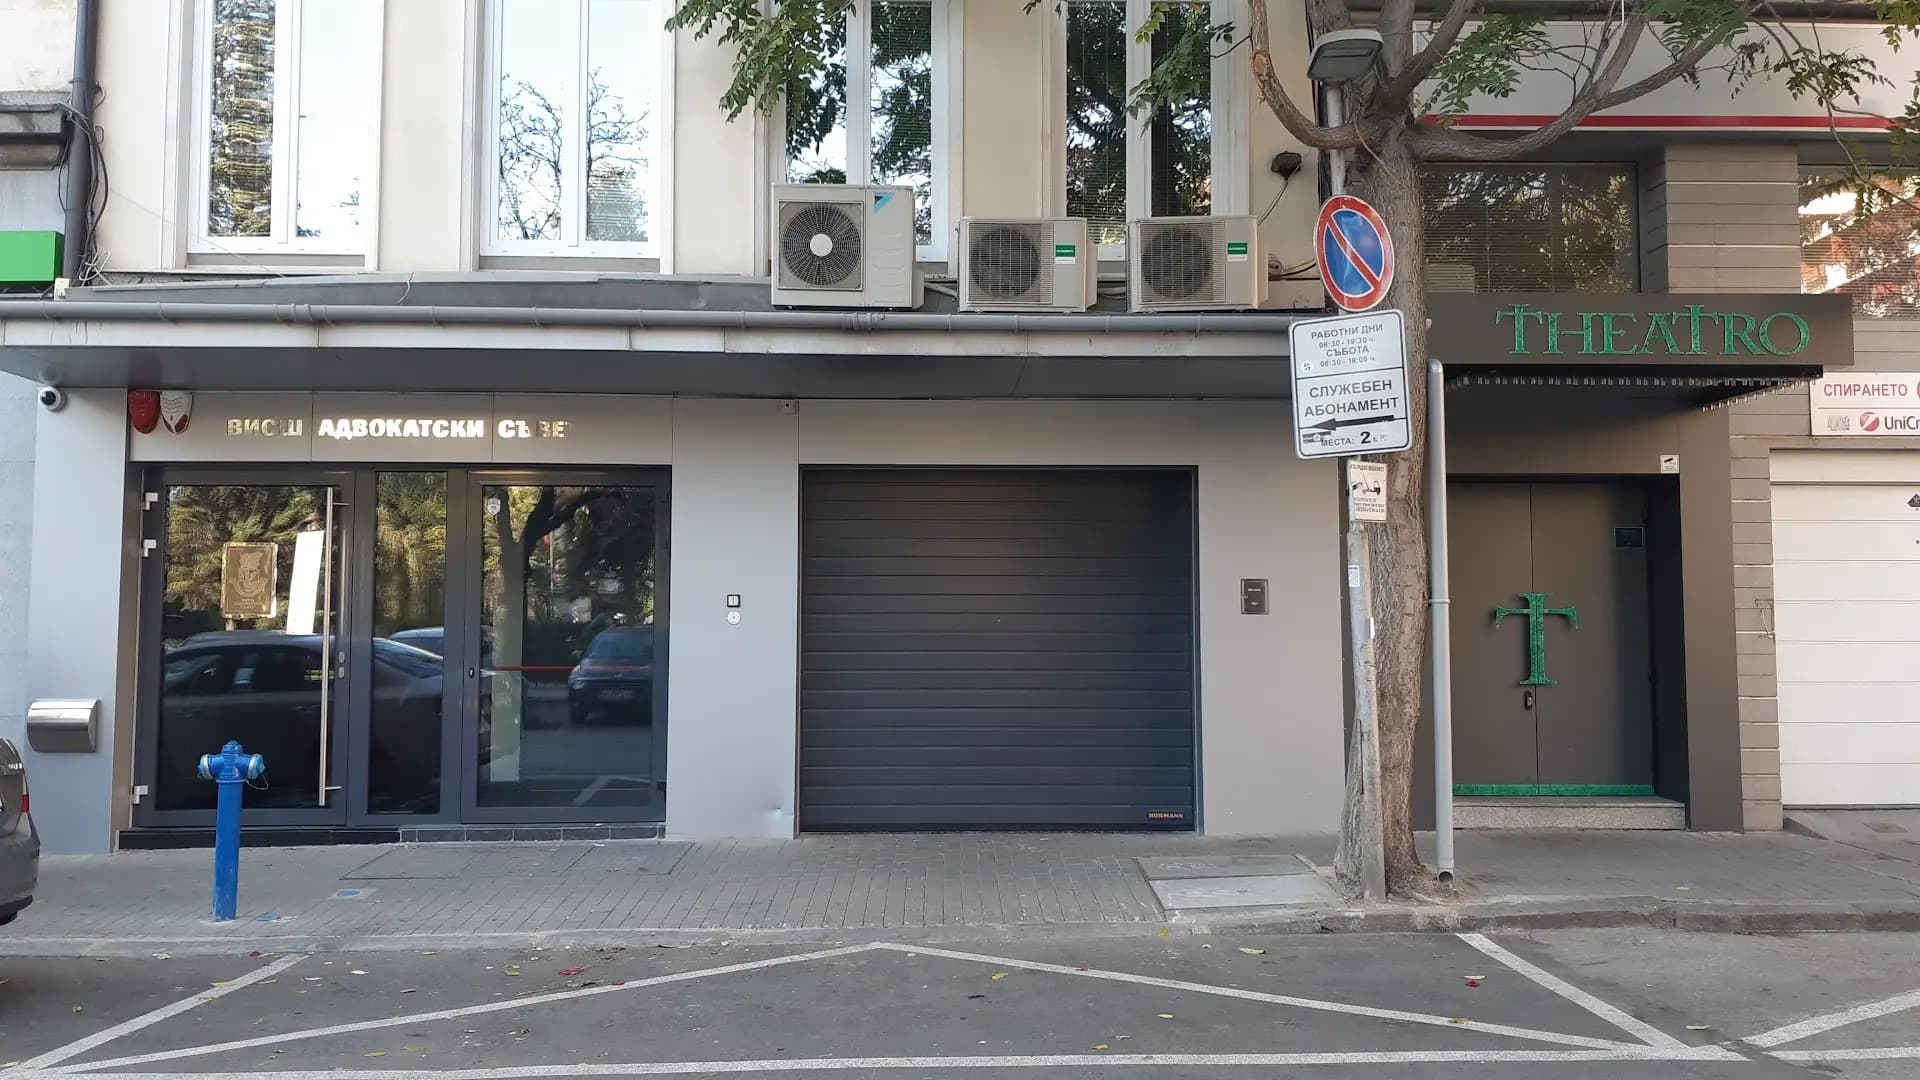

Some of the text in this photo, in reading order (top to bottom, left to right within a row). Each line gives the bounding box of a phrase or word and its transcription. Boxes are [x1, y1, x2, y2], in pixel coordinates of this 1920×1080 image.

[1311, 323, 1383, 340] РАБОТНИ ДНИ
[1496, 304, 1811, 357] THEATRO
[1326, 345, 1369, 357] СЪБОТА
[1309, 379, 1392, 398] СЛУЖЕБЕН
[1823, 383, 1908, 397] СПИРАНЕТО
[1304, 397, 1399, 417] АБОНАМЕНТ
[318, 418, 485, 441] АДВОКАТСКИ
[498, 419, 576, 438] СЪВЕ
[1360, 430, 1372, 444] 2
